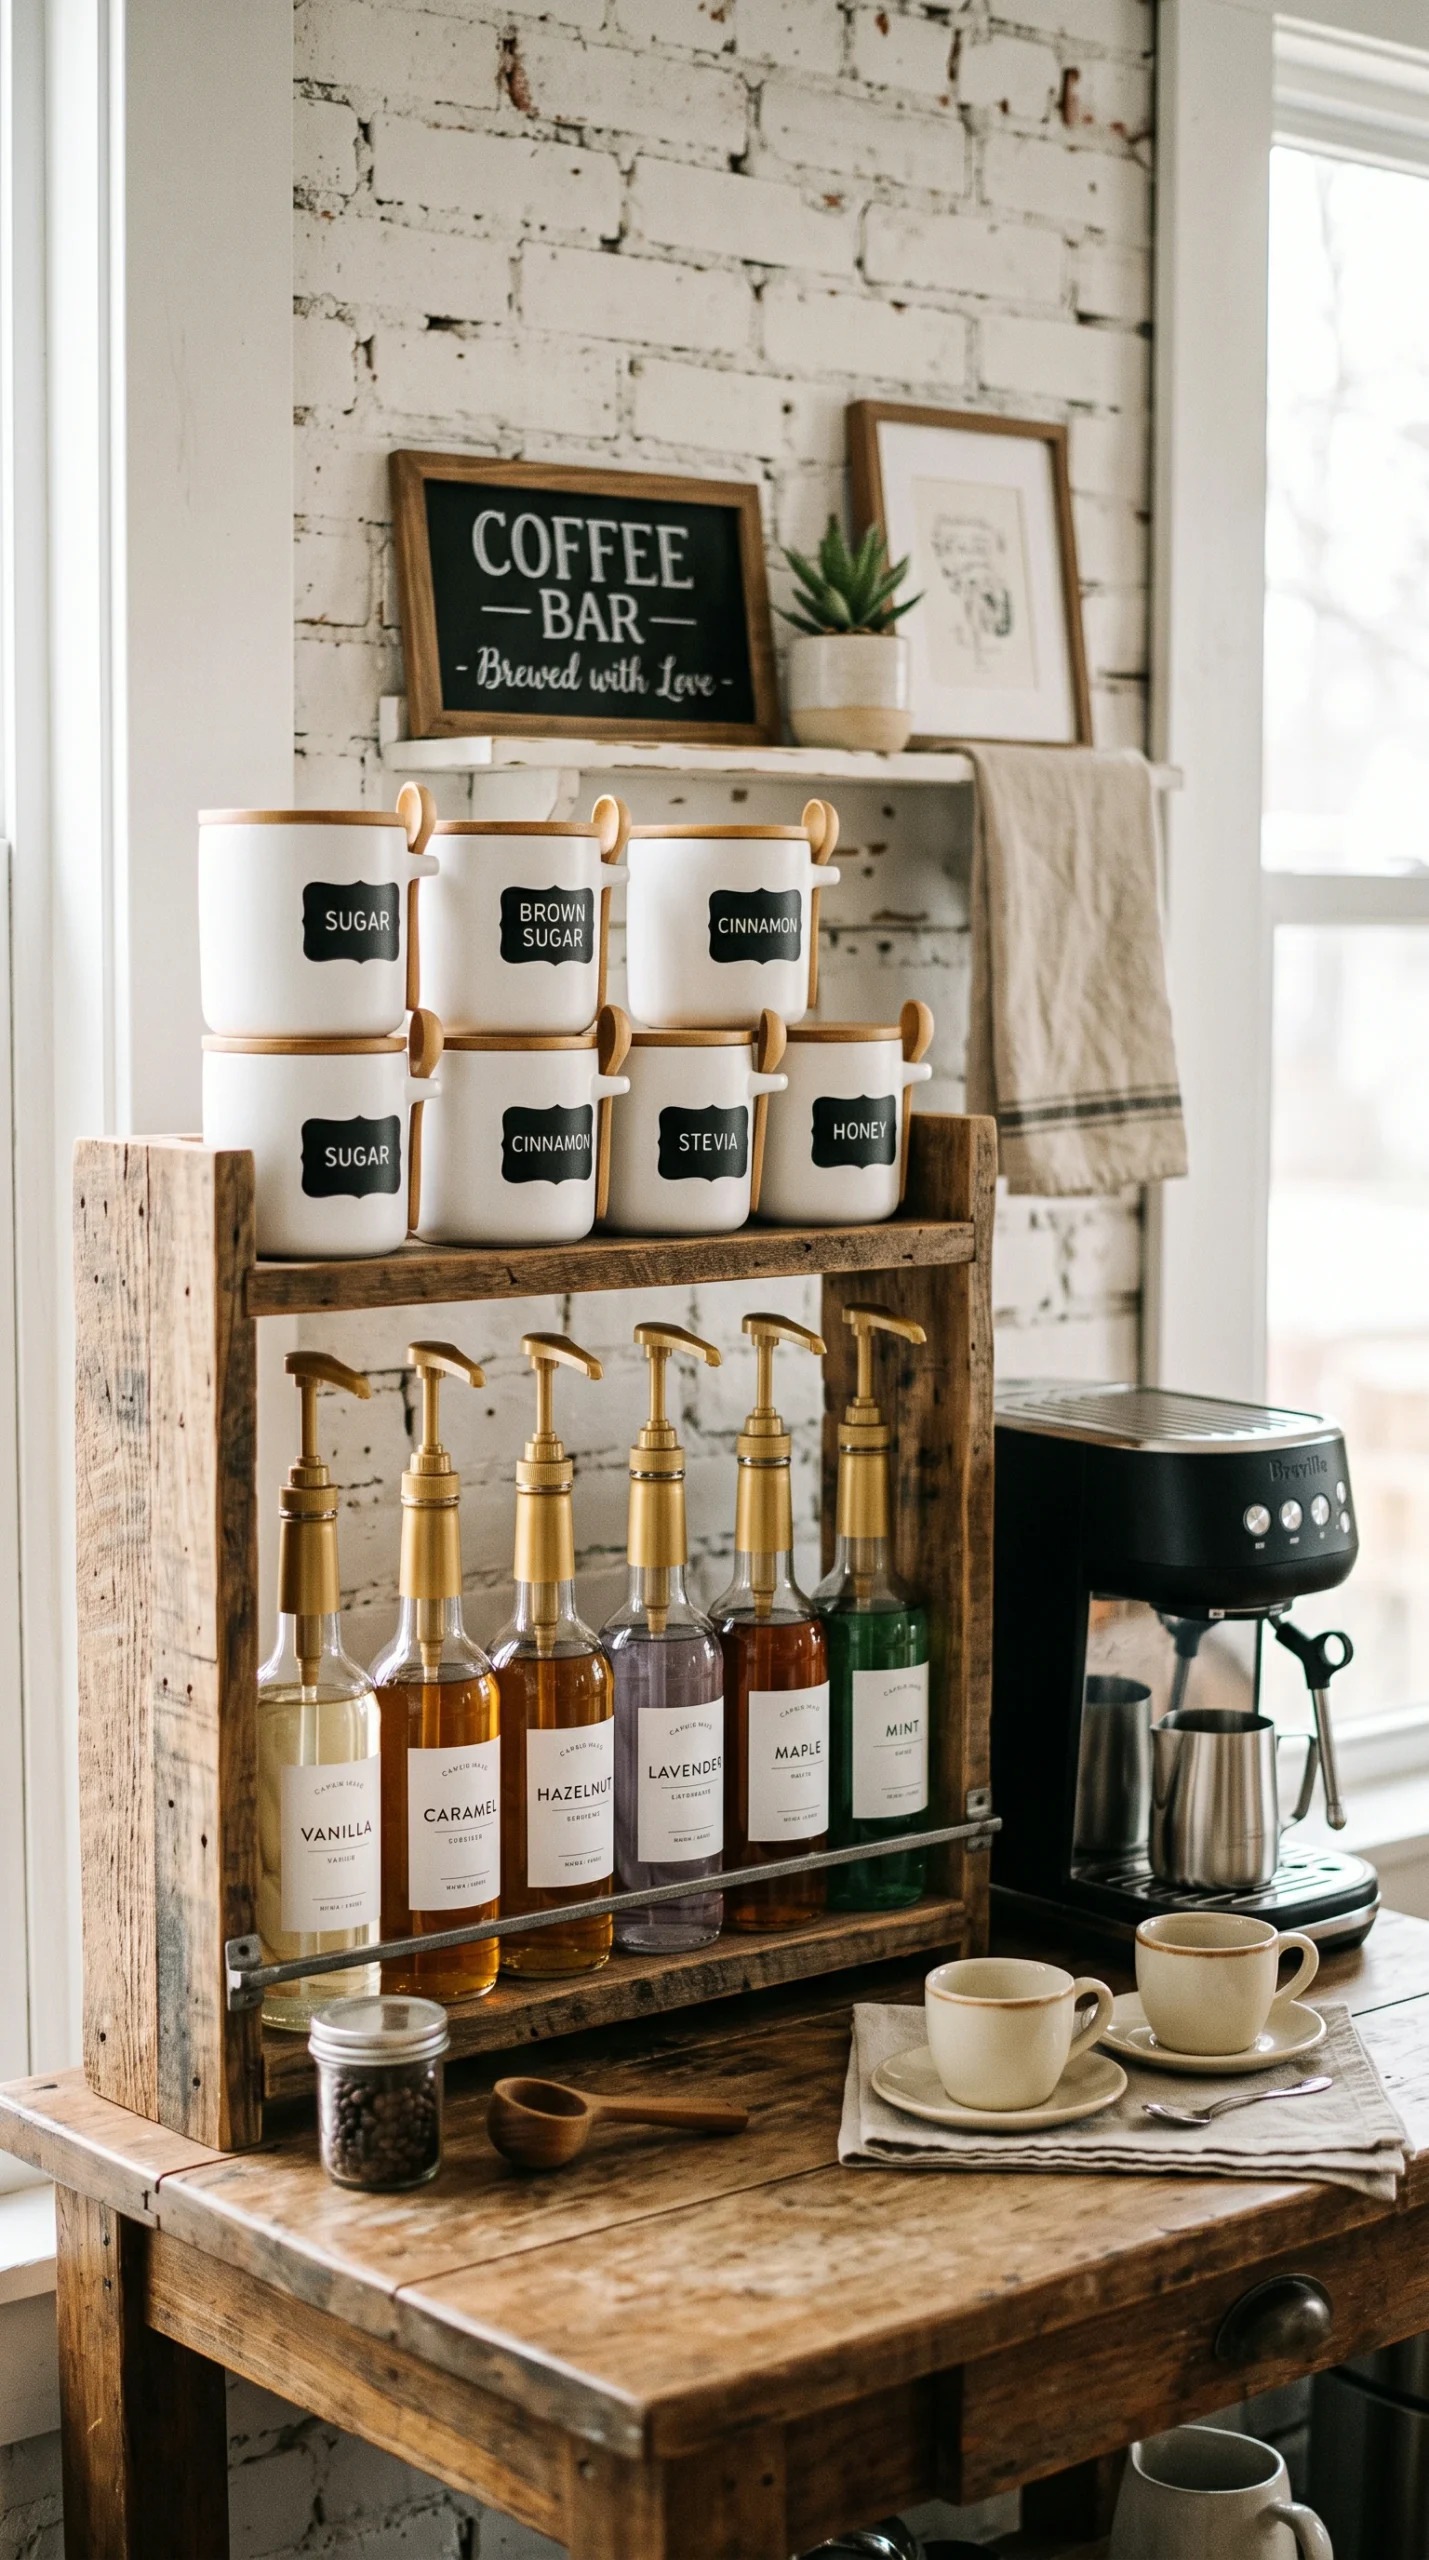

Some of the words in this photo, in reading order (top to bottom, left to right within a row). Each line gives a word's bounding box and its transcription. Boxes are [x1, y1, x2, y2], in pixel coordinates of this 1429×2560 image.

[472, 509, 695, 589] COFFEE
[539, 588, 646, 645] BAR
[476, 646, 582, 691] Brewed
[589, 654, 650, 695] with
[655, 654, 716, 703] Love
[324, 910, 391, 932] SUGAR
[519, 902, 587, 924] BROWN
[717, 916, 799, 935] CINNAMON
[522, 927, 585, 948] SUGAR
[832, 1120, 888, 1142] HONEY
[511, 1132, 591, 1154] CINNAMON
[678, 1132, 739, 1153] STEVIA
[324, 1145, 390, 1168] SUGAR
[1268, 1454, 1328, 1481] Breville
[885, 1719, 920, 1738] MINT
[774, 1740, 822, 1760] MAPLE
[648, 1755, 722, 1780] LAVENDER
[537, 1776, 612, 1802] HAZELNUT
[423, 1799, 497, 1823] CARAMEL
[300, 1819, 372, 1843] VANILLA
